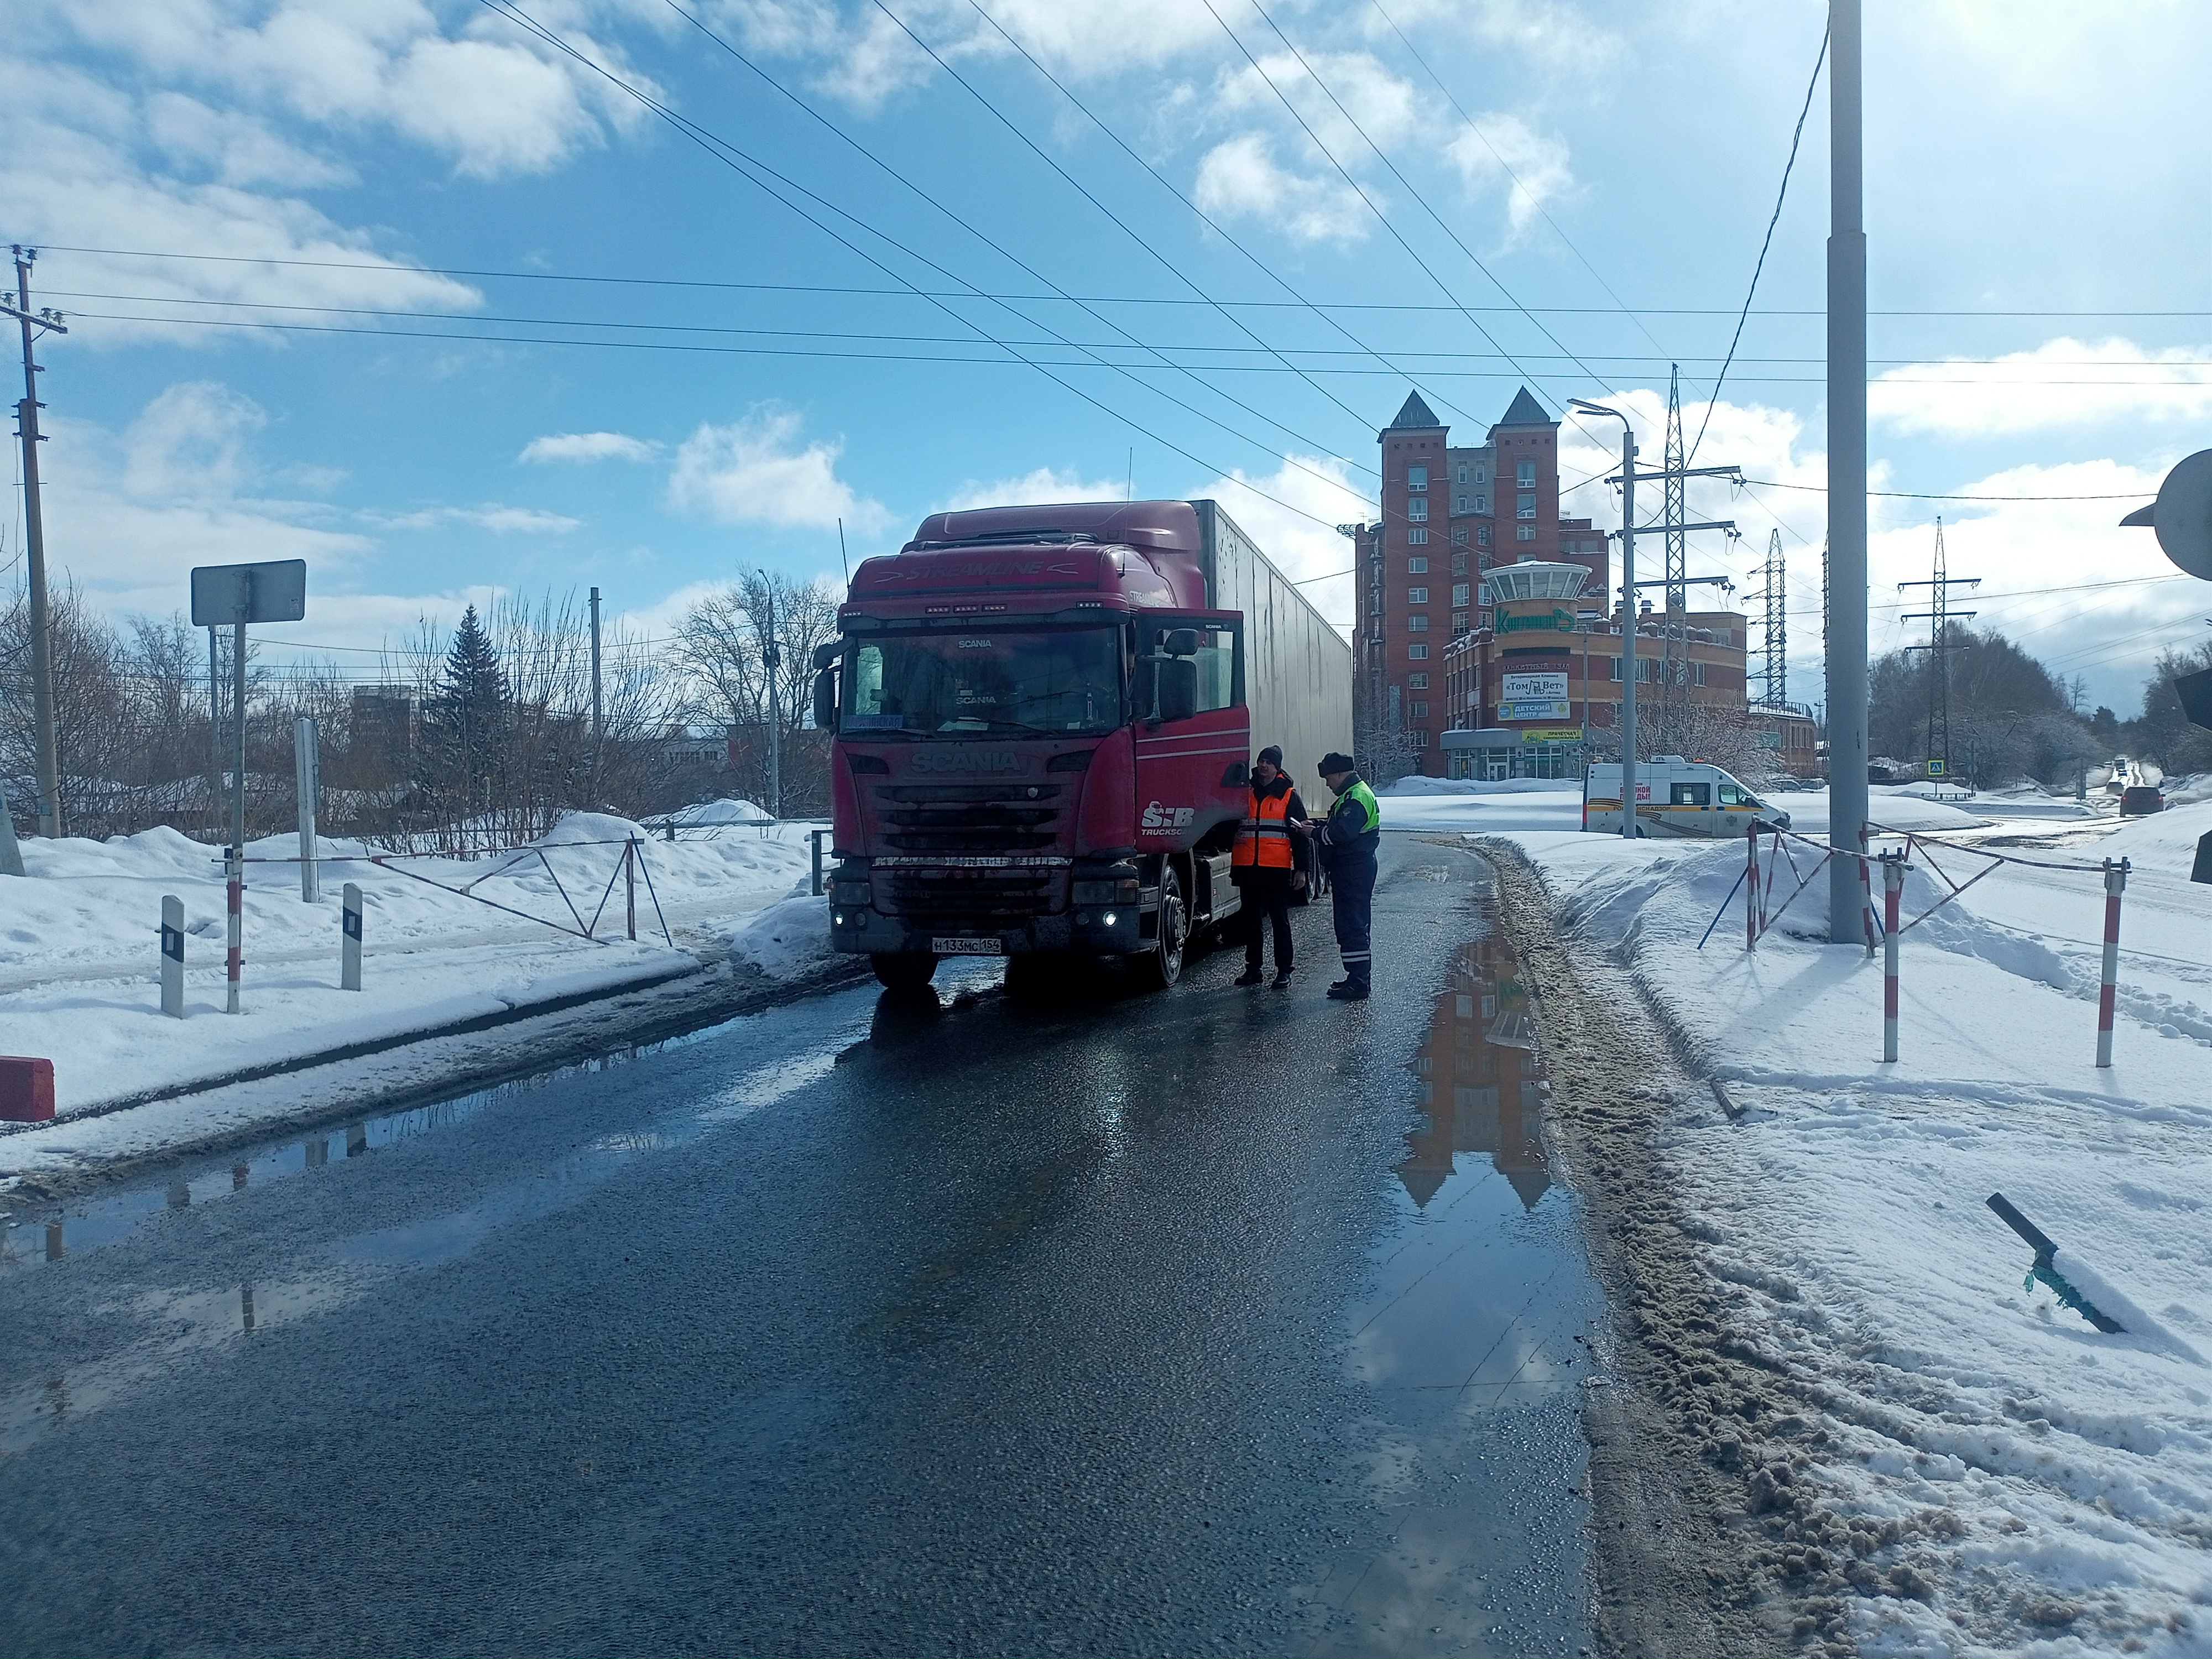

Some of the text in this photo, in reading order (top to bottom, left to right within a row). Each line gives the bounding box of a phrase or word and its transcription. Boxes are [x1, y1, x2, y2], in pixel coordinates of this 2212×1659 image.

[906, 560, 1044, 581] STREAMLINE
[958, 640, 992, 648] SCANIA
[1515, 704, 1551, 712] ДЕТСКИЙ
[911, 752, 1021, 773] SCANIA
[982, 940, 1000, 949] 154
